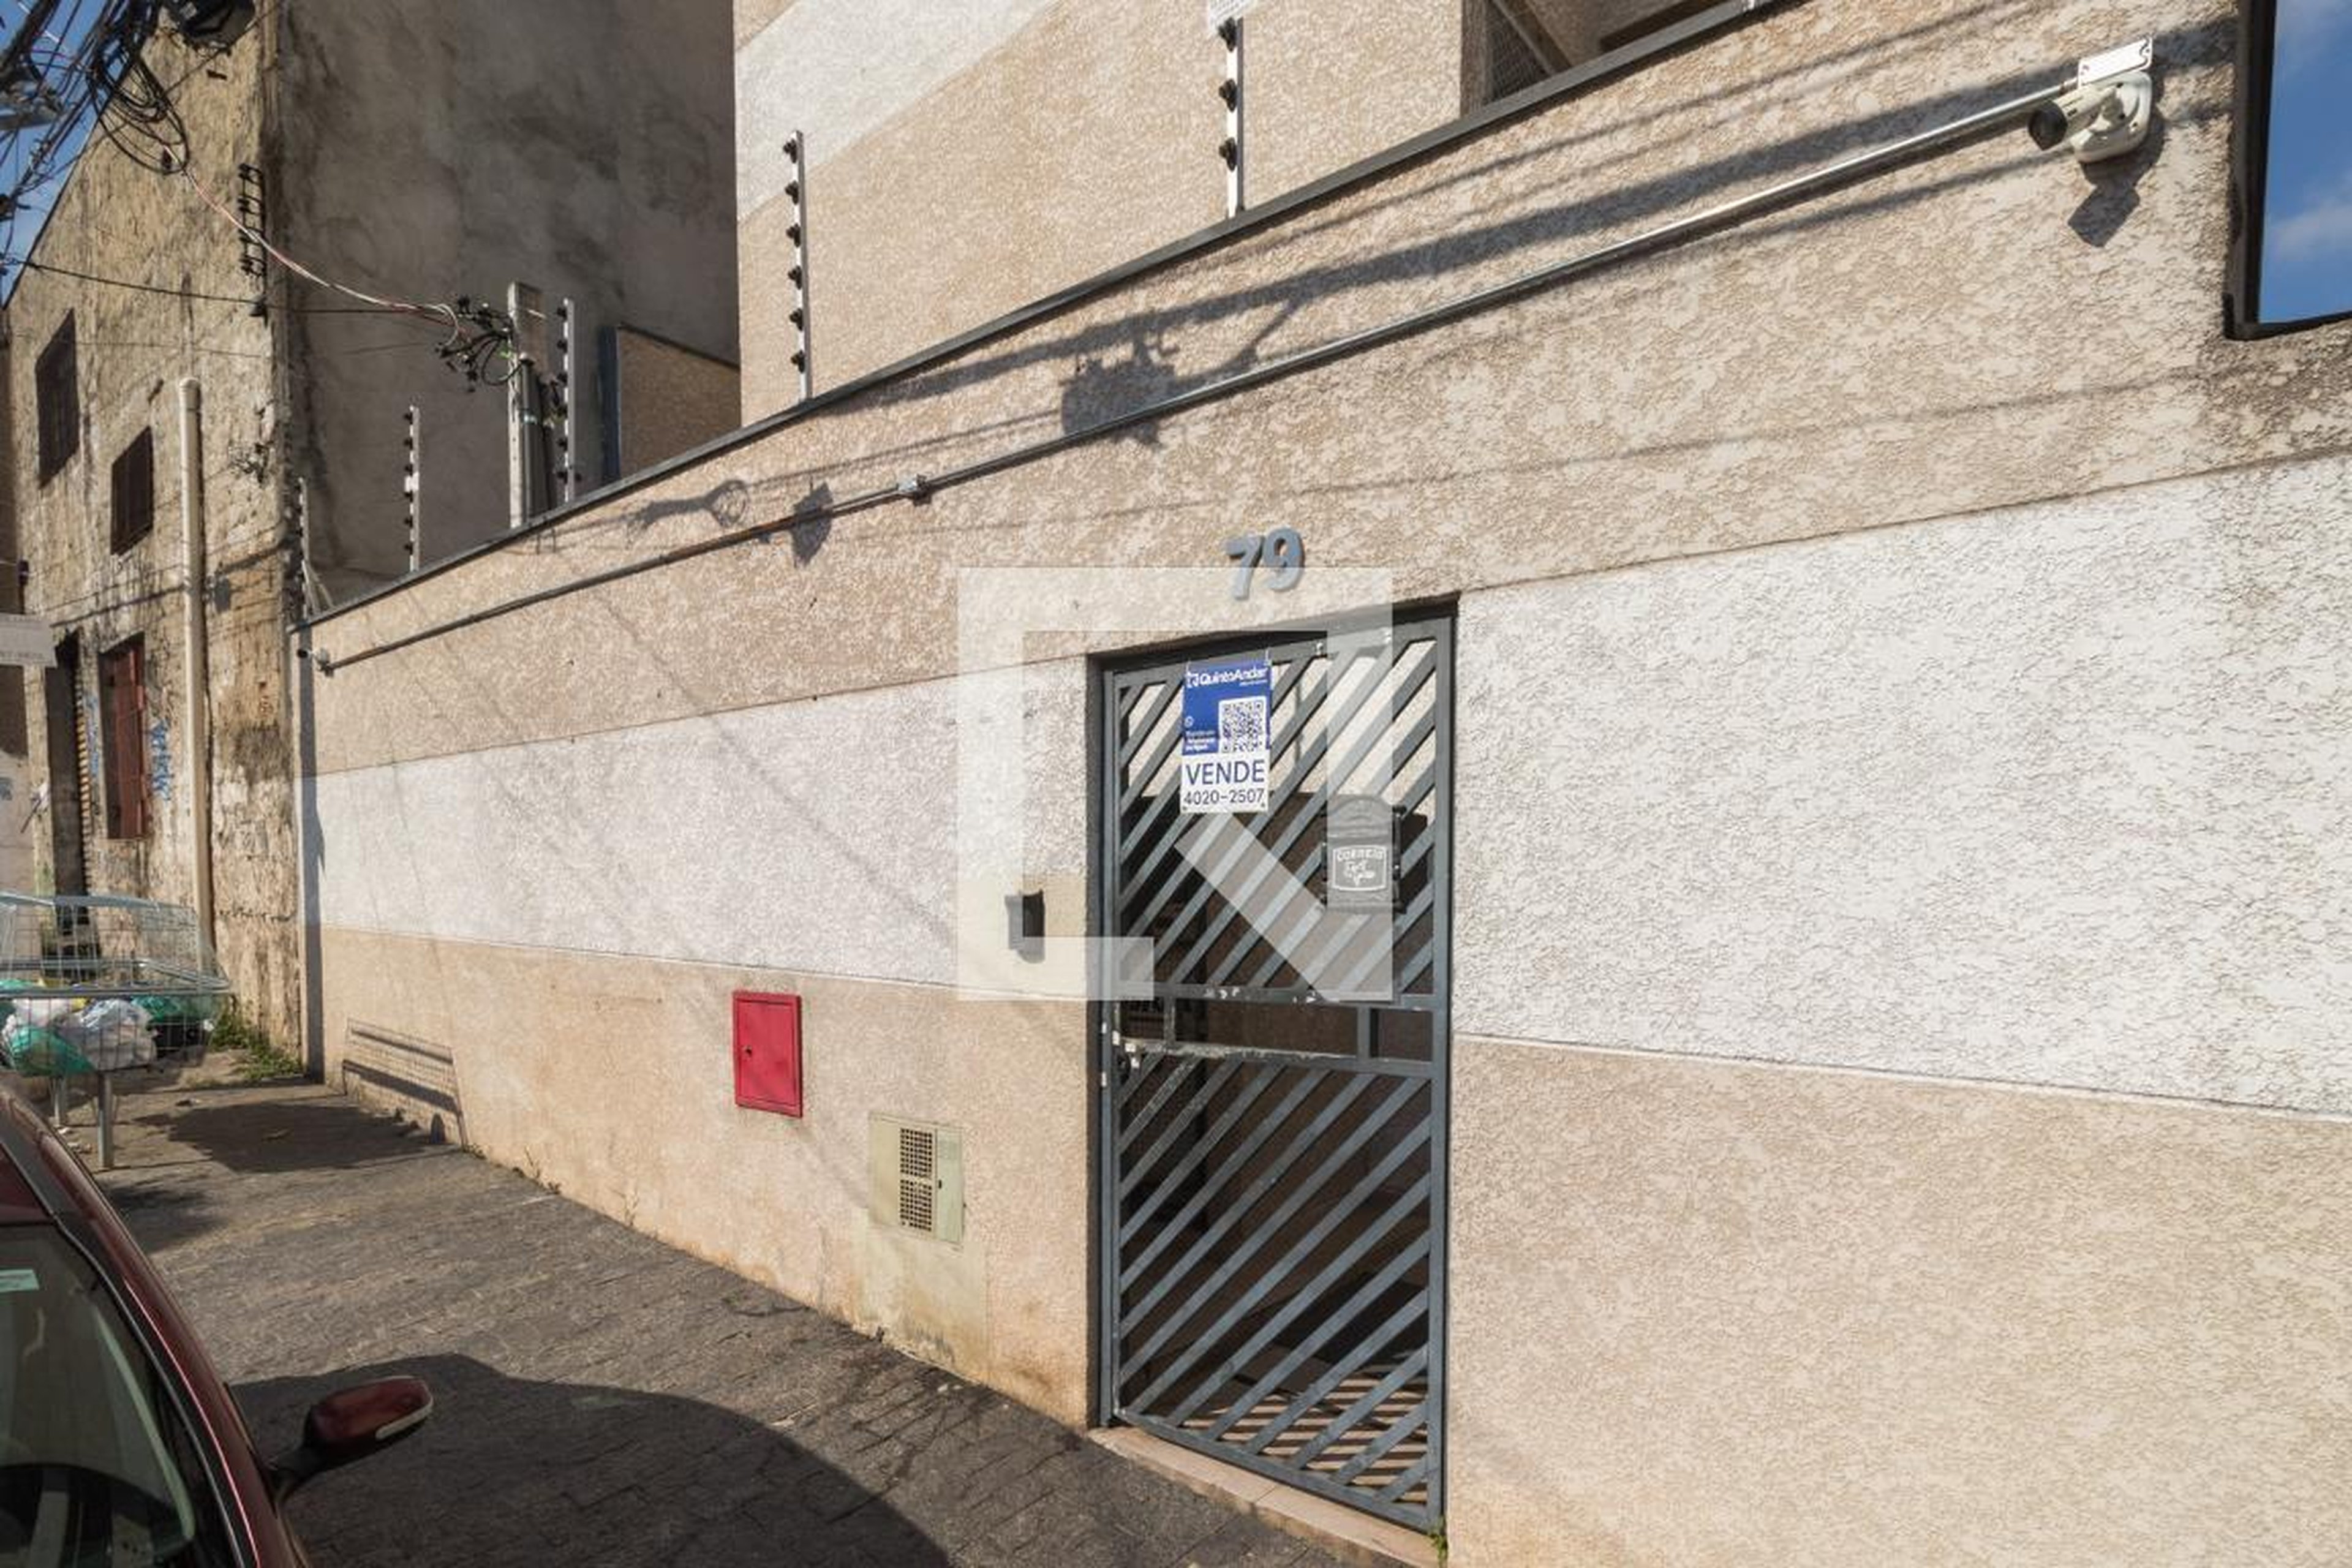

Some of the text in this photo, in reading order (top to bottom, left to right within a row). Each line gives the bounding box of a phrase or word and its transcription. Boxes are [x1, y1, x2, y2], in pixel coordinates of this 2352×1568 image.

[1225, 527, 1305, 601] 79
[1185, 760, 1264, 785] VENDE
[1183, 787, 1264, 805] 4020-2507
